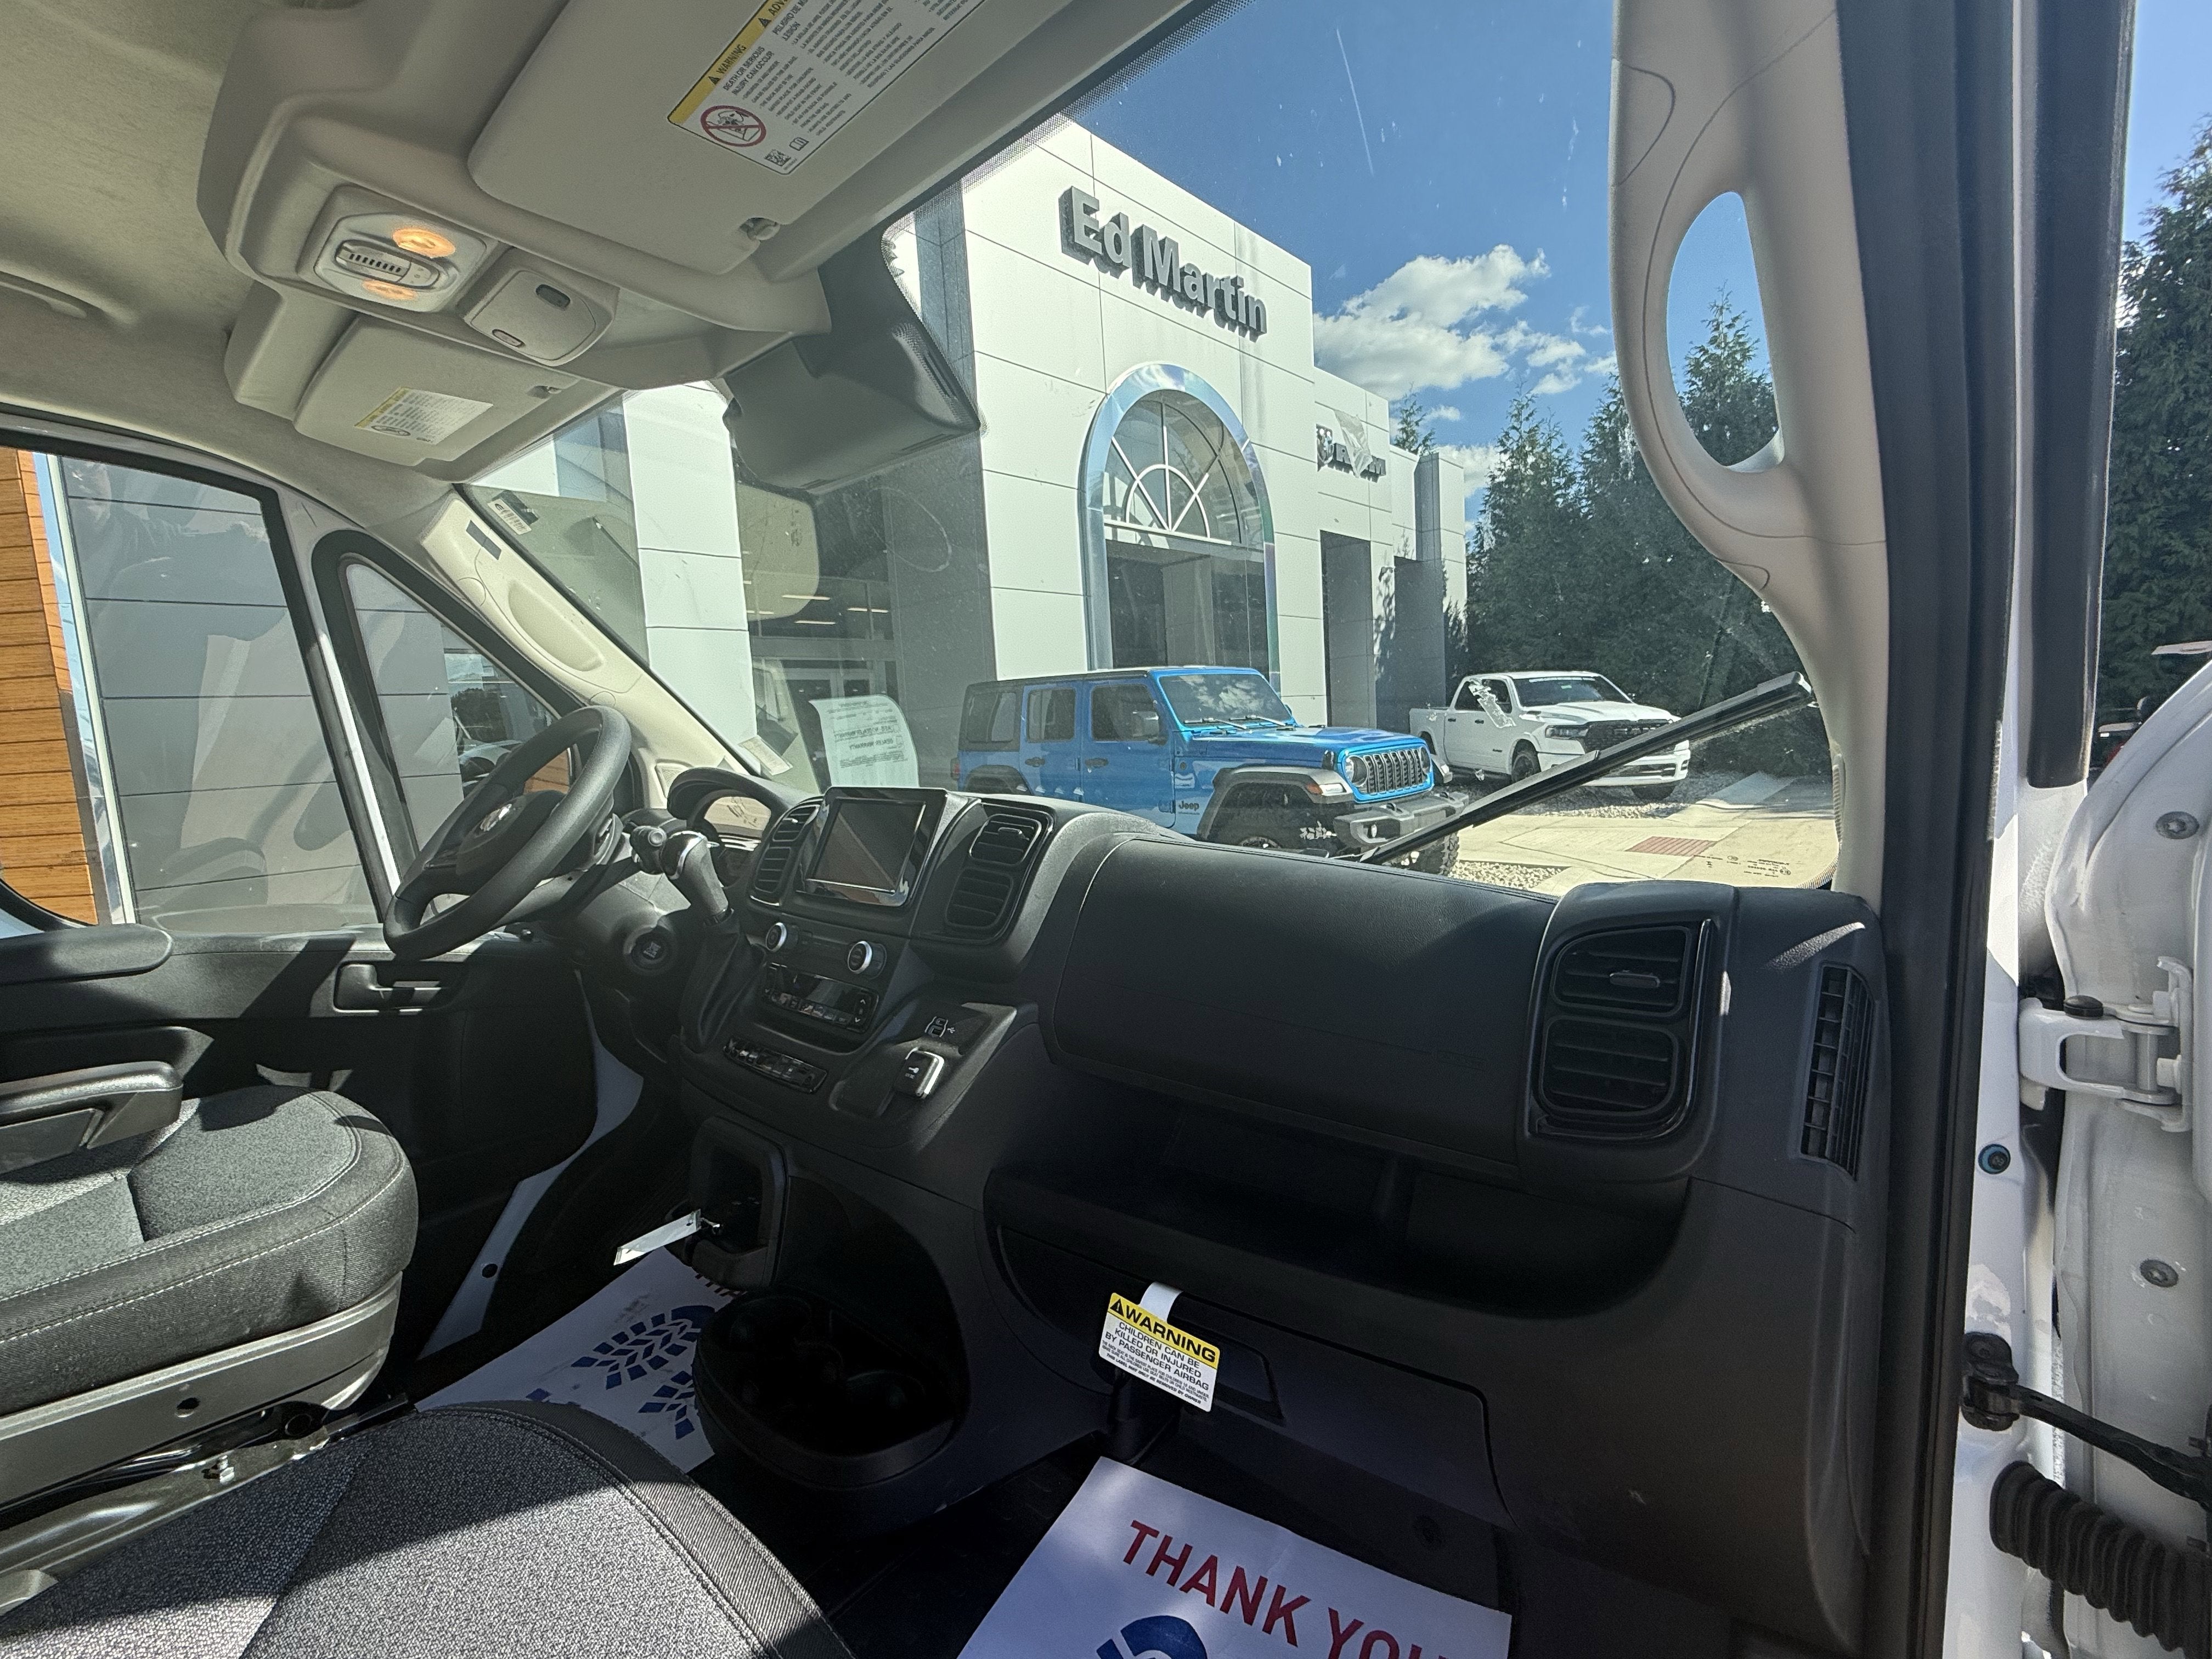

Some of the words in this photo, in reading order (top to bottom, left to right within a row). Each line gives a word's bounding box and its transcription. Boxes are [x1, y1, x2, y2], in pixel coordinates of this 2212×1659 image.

[716, 44, 746, 74] WARNING
[723, 74, 738, 91] DEATH
[737, 66, 746, 76] OR
[743, 46, 765, 69] SERIOUS
[746, 66, 759, 79] CAN
[756, 50, 772, 70] OCCUR
[1060, 186, 1132, 276] Ed
[1132, 224, 1267, 339] Martin
[1333, 443, 1386, 482] RM
[1178, 800, 1199, 811] Jeep
[1114, 1328, 1143, 1349] KILLED
[1145, 1345, 1158, 1357] OR
[1160, 1352, 1201, 1379] INJURED
[1119, 1321, 1162, 1351] CHILDREN
[1164, 1345, 1184, 1362] CAN
[1187, 1357, 1200, 1369] BE
[1125, 1305, 1216, 1364] WARNING
[1105, 1331, 1116, 1343] BY
[1118, 1339, 1171, 1372] PASSENGER
[1173, 1368, 1209, 1391] AIRBAG
[1122, 1520, 1311, 1647] THANK
[1328, 1607, 1449, 1659] YO
